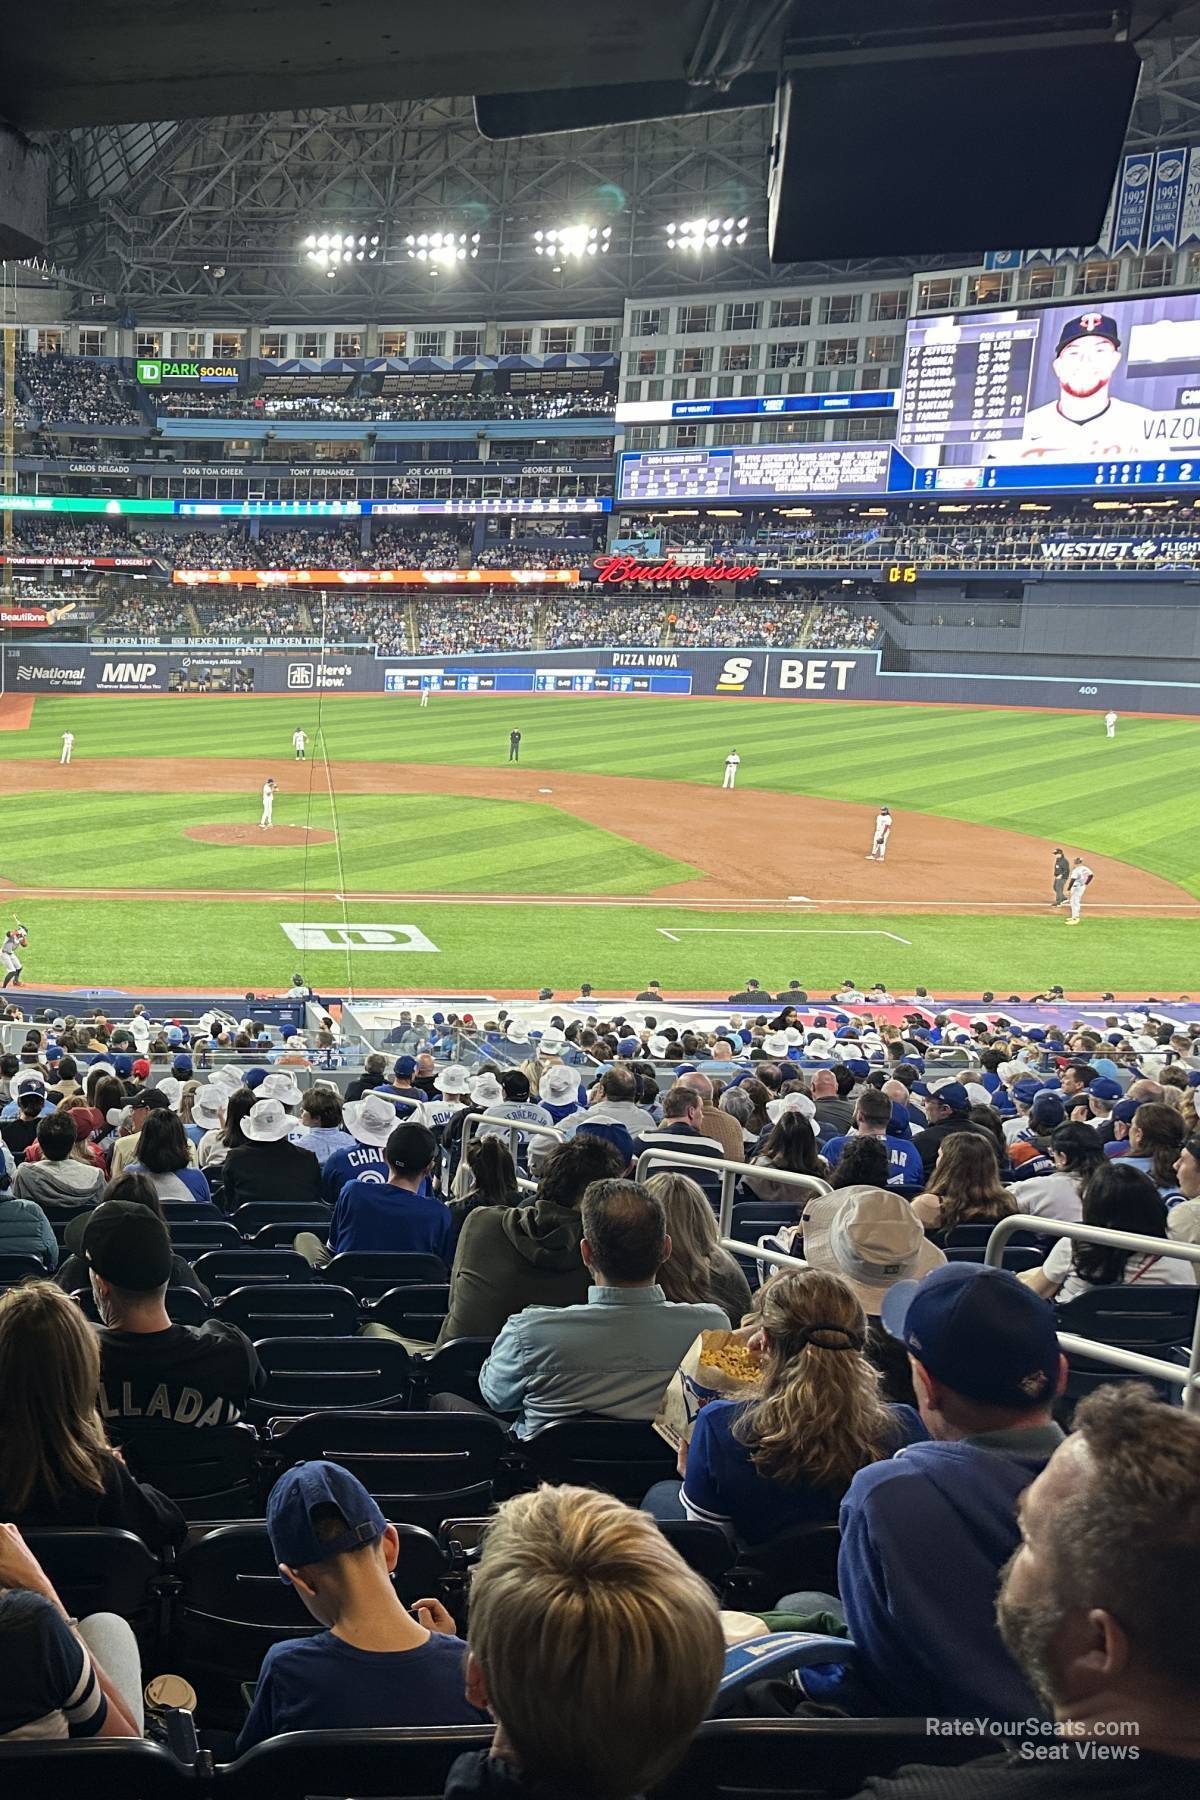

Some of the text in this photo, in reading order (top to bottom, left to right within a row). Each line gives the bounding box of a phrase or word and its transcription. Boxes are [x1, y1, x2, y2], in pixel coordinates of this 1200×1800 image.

[1157, 185, 1179, 200] 1993
[1188, 183, 1200, 197] 20
[1123, 190, 1145, 205] 1992
[923, 345, 956, 355] JEFFERS
[922, 356, 953, 366] CORREA
[140, 363, 238, 379] TD PARK SOCIAL
[921, 367, 952, 377] CASTRO
[920, 378, 955, 388] MIRANDA
[919, 389, 952, 399] MARGOT
[918, 400, 953, 410] SANTANA
[916, 411, 949, 421] FARMER
[1144, 417, 1200, 440] VAZQ
[914, 433, 944, 443] MARTIN
[70, 464, 129, 473] CARLOS DELGADO
[522, 466, 552, 474] GEORGE
[1179, 463, 1192, 480] 2
[1040, 542, 1132, 557] WESTJET
[65, 557, 78, 565] Blue
[593, 555, 760, 583] Budweiser
[1, 613, 44, 621] BeautiTone
[106, 637, 138, 645] NEXEN
[140, 637, 160, 645] TIRE
[188, 637, 220, 645] NEXEN
[270, 637, 301, 645] NEXEN
[613, 653, 678, 667] PIZZA NOVA
[101, 663, 156, 682] MNP
[316, 665, 352, 675] Here's
[780, 660, 856, 690] BET
[1079, 686, 1097, 695] 400
[299, 928, 412, 944] TD
[432, 1111, 454, 1125] ROM
[504, 1111, 538, 1120] ERRERO
[891, 1149, 908, 1167] AR
[99, 1381, 243, 1430] LLADA
